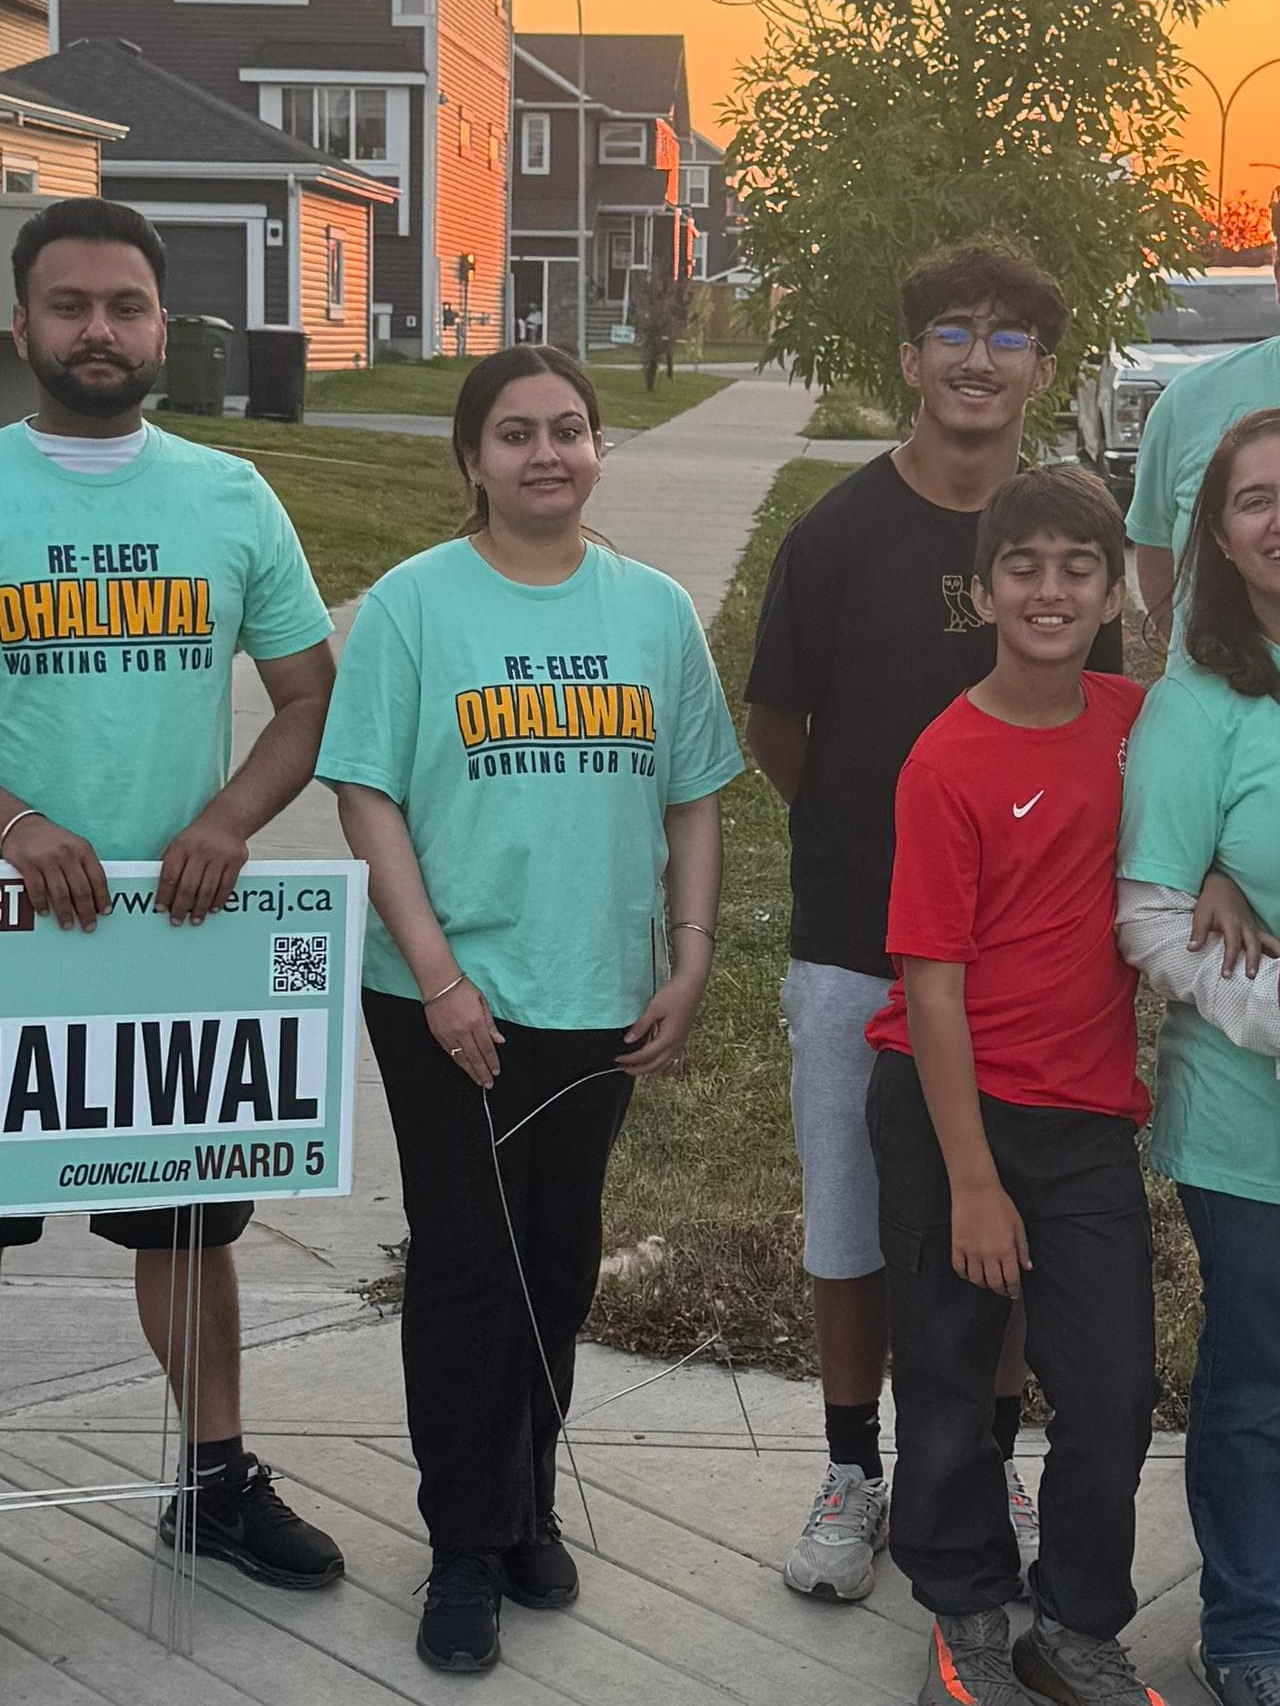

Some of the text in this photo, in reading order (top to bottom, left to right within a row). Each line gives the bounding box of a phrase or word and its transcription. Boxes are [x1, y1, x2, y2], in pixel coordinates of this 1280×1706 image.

[47, 543, 160, 574] RE-ELECT
[4, 646, 213, 676] WORKING FOR YOU
[504, 655, 609, 680] RE-ELECT
[455, 683, 657, 749] DHALIWAL
[468, 750, 656, 781] WORKING FOR YOU
[59, 1141, 325, 1187] COUNCILLOR WARD 5
